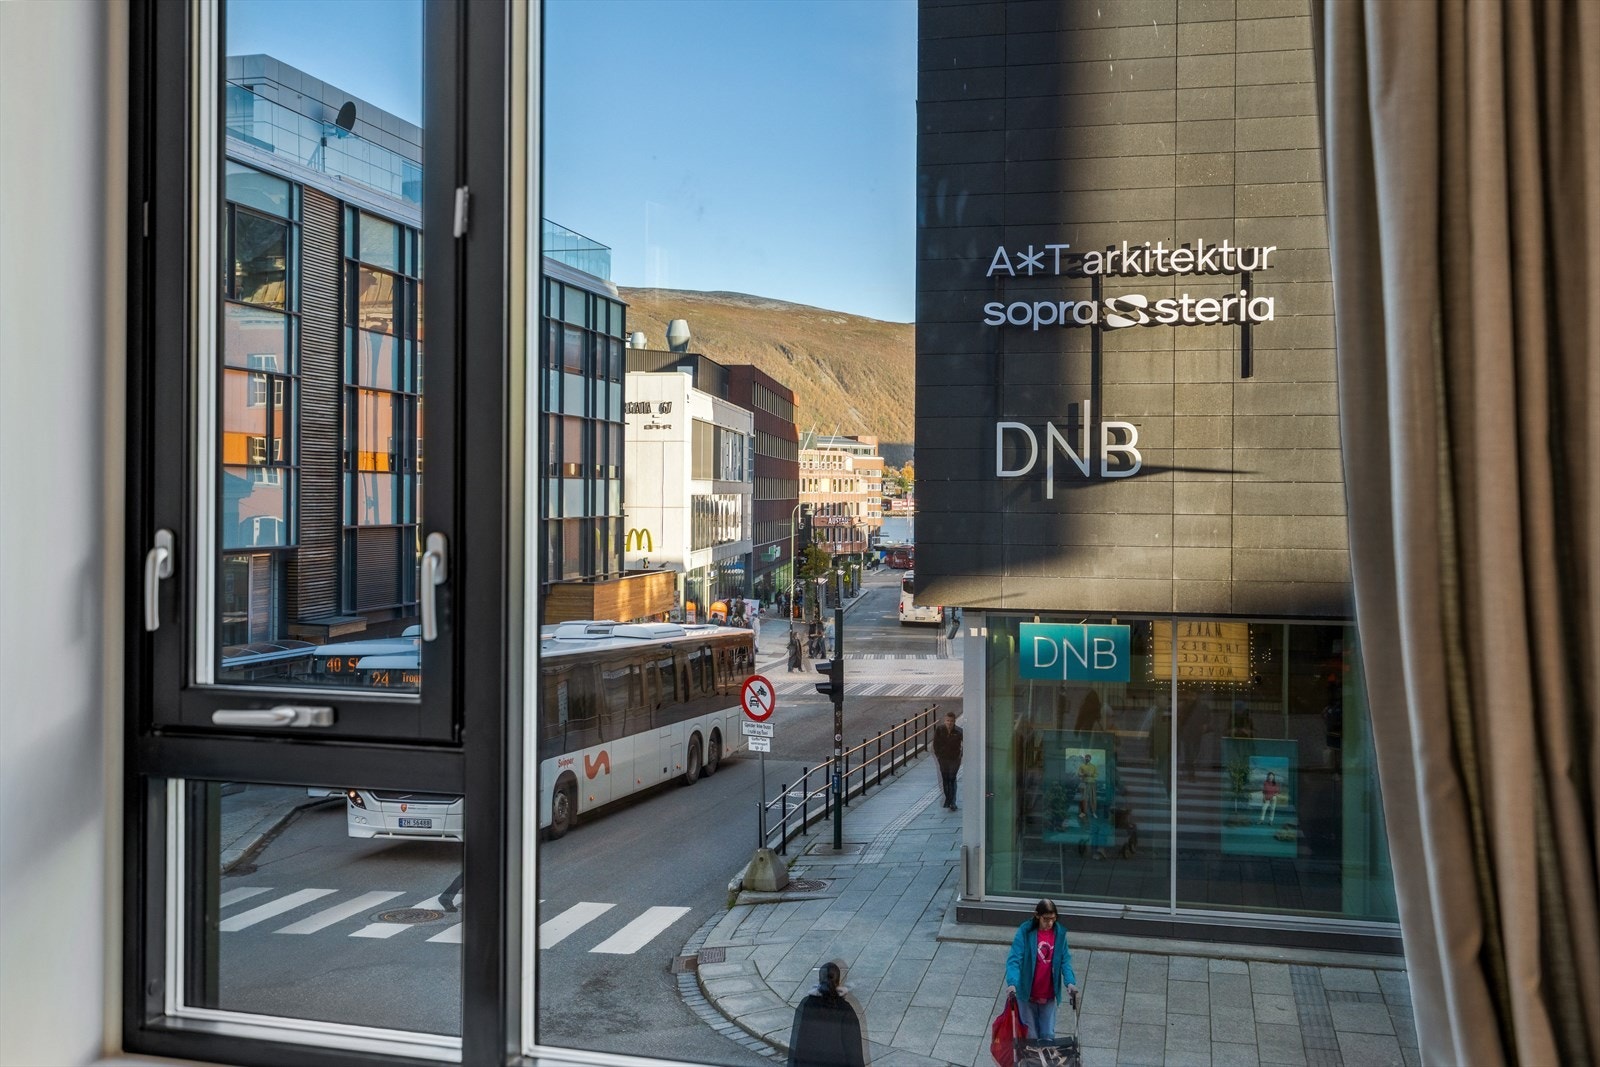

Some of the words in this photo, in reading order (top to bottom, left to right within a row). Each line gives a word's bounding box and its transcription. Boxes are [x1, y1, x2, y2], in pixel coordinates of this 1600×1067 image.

[1083, 238, 1277, 274] arkitektur
[983, 300, 1098, 331] sopra
[1155, 289, 1275, 323] steria
[996, 399, 1142, 500] DNB
[327, 657, 341, 672] 40
[1034, 624, 1117, 680] DNB
[372, 672, 389, 687] 24
